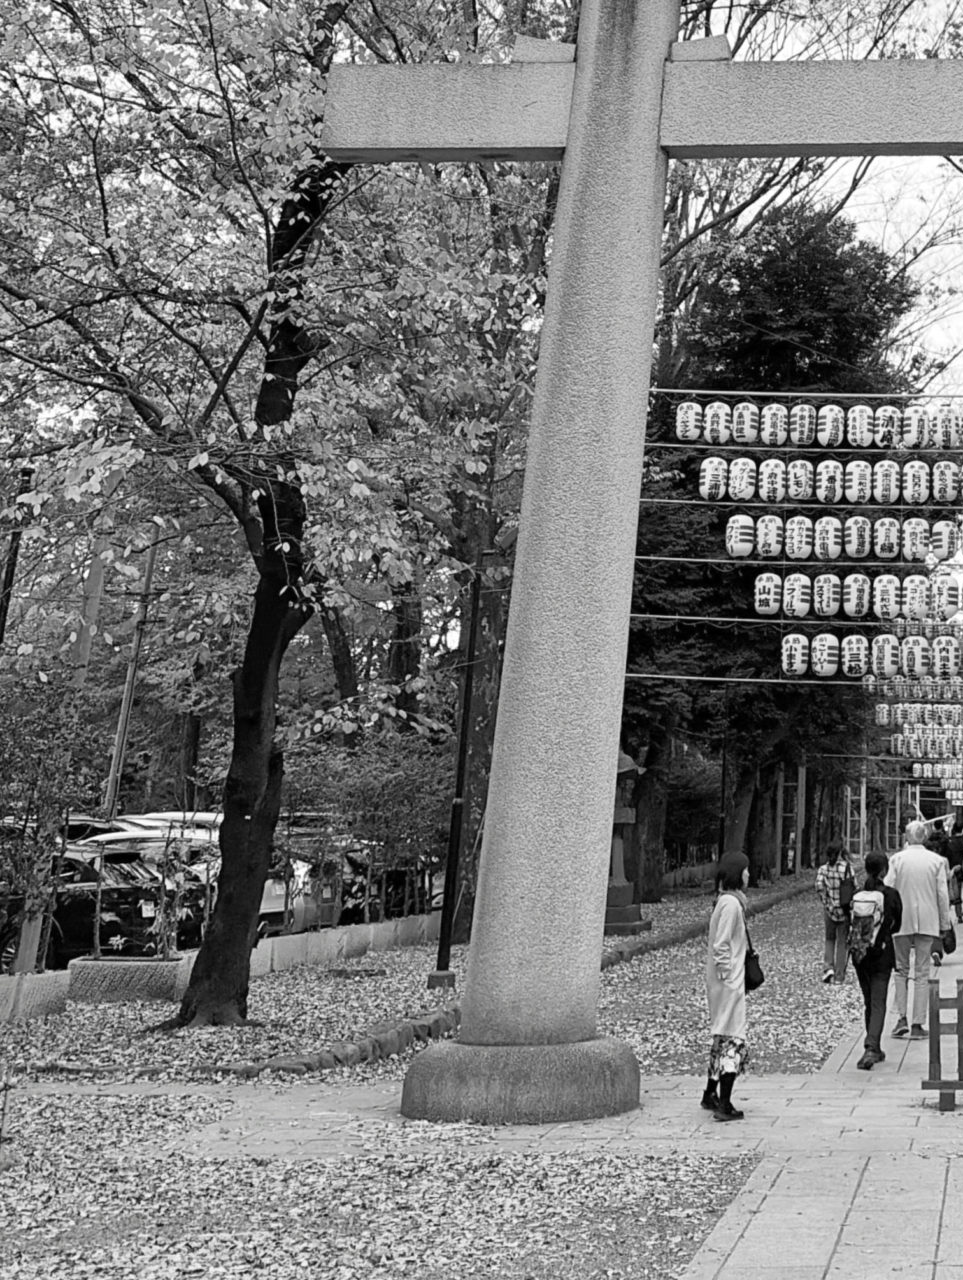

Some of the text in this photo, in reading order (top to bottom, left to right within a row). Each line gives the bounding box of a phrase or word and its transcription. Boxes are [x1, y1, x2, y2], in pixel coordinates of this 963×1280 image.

[793, 472, 804, 497] レモン
[816, 585, 827, 614] スマイル
